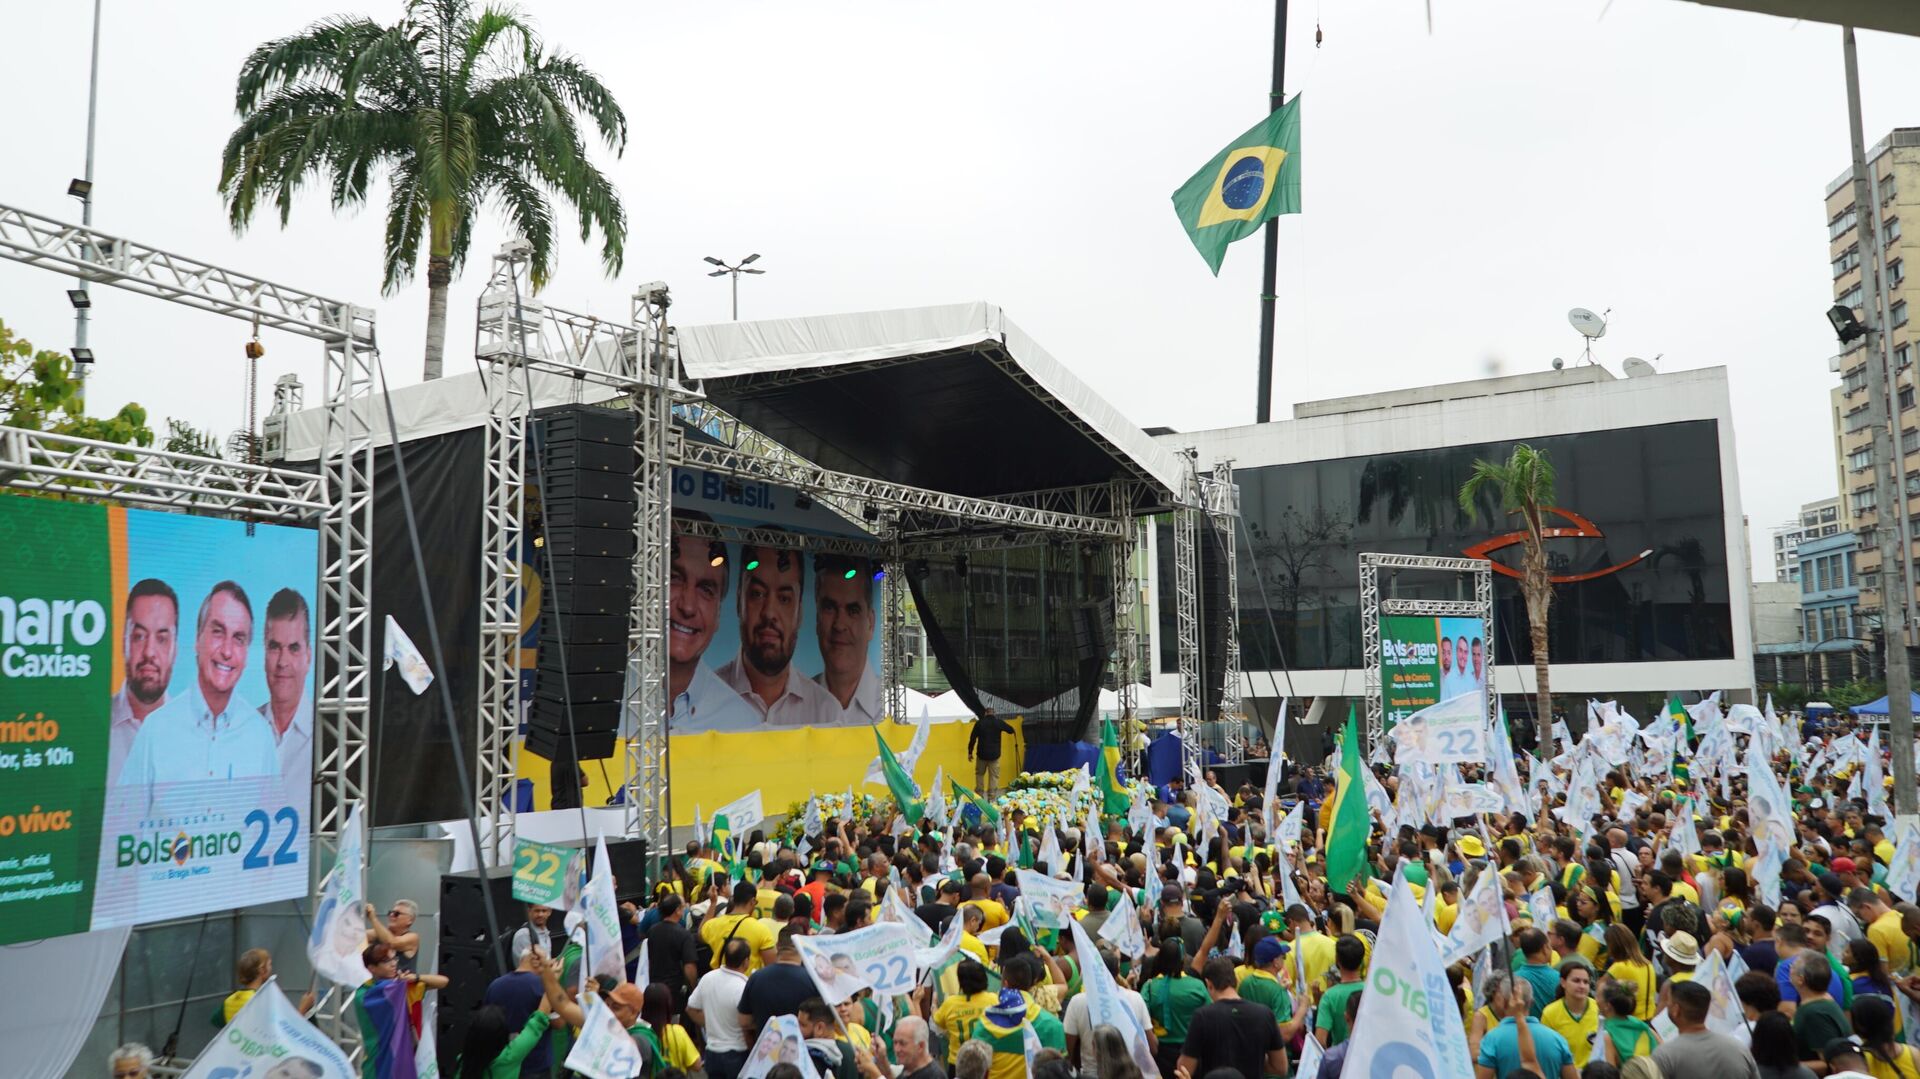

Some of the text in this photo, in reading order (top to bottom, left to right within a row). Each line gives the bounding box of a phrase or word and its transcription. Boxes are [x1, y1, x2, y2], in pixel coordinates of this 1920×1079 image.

[2, 645, 91, 677] Caxias
[1382, 639, 1438, 657] Bolsonaro
[45, 747, 74, 766] 10h
[1438, 729, 1478, 755] 22
[19, 805, 72, 834] vivo:
[117, 806, 299, 870] Bolsonaro 22
[514, 848, 560, 887] 22
[866, 955, 911, 990] 22
